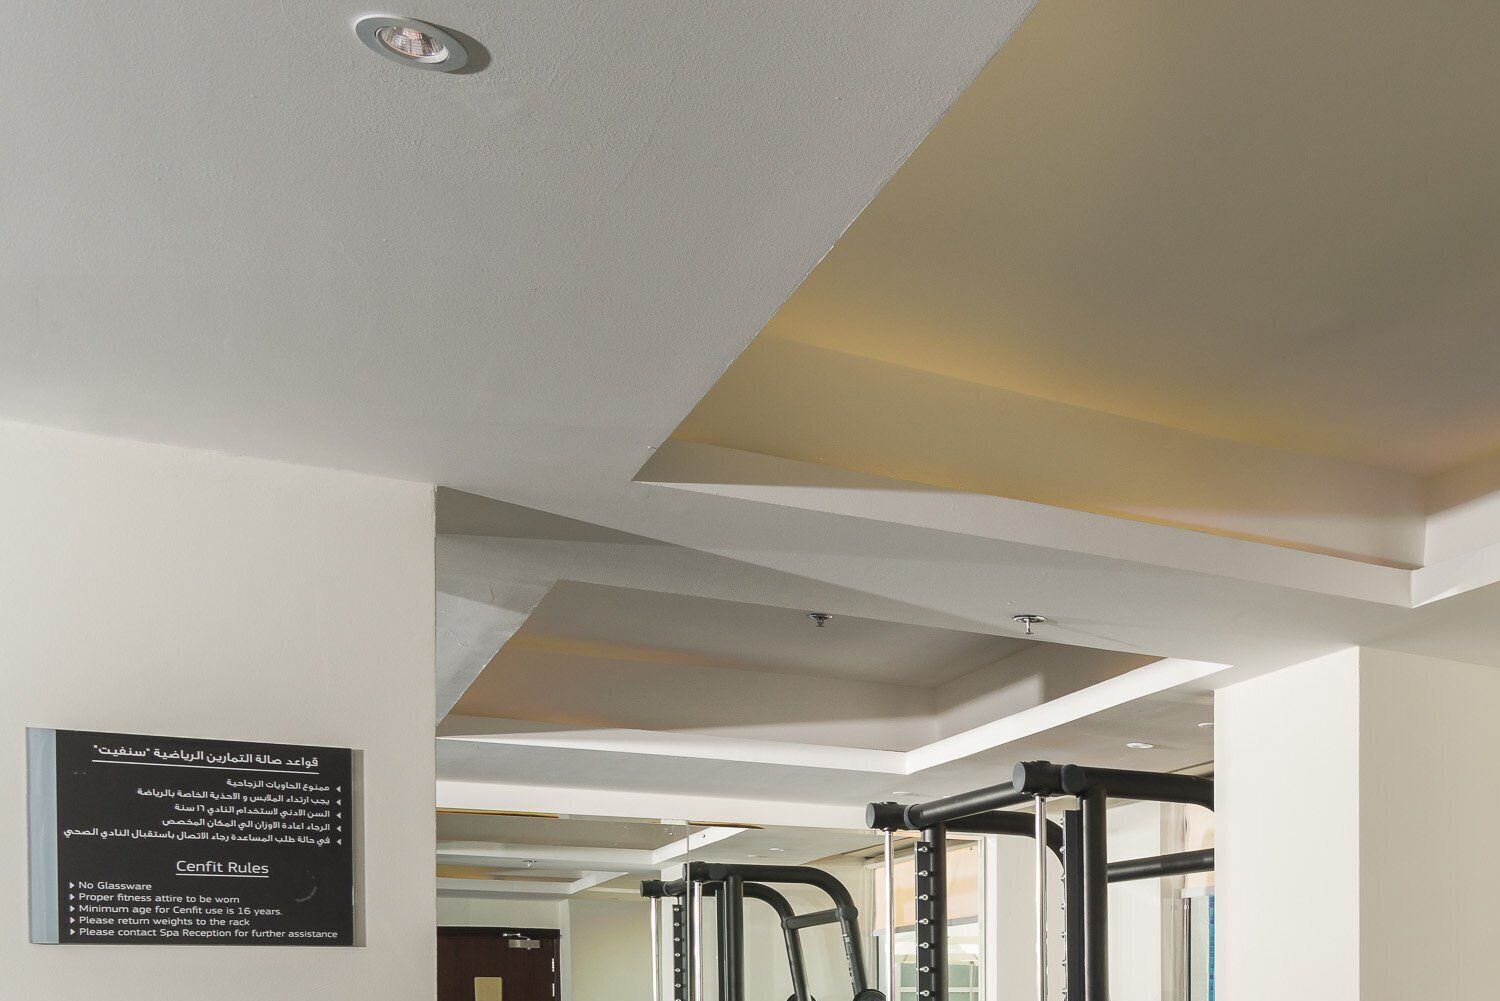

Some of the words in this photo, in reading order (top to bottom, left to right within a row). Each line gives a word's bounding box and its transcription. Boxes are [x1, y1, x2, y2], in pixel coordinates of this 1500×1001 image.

[153, 748, 204, 762] الرياضية
[206, 753, 253, 763] التمارين
[255, 754, 282, 765] صالة
[286, 757, 319, 769] قواعد
[226, 778, 264, 789] الزجاجية
[265, 781, 301, 790] الحاويات
[302, 783, 330, 791] ممنوع
[137, 787, 176, 798] بالرياضة
[176, 790, 208, 799] الخاصة
[210, 791, 241, 800] الاحذية
[249, 795, 284, 803] الملابس
[286, 795, 309, 805] ارتداء
[311, 798, 330, 806] يجب
[174, 803, 195, 812] سنة
[207, 806, 235, 816] النادي
[236, 808, 278, 816] لاستخدام
[307, 810, 330, 819] السن
[162, 818, 205, 826] المخصص
[207, 819, 236, 828] المكان
[254, 820, 280, 830] الاوزان
[282, 821, 304, 830] اعادة
[306, 823, 330, 832] الرجاء
[63, 827, 99, 839] الصحي
[100, 828, 130, 839] النادي
[131, 830, 176, 839] باستقبال
[177, 831, 209, 841] الاتصال
[211, 832, 229, 842] رجاء
[230, 833, 273, 842] المساعدة
[275, 835, 295, 843] طلب
[297, 835, 315, 844] حالة
[316, 837, 331, 847] في
[176, 860, 223, 873] Cenfit
[228, 862, 269, 874] Rules
[79, 881, 94, 890] No
[97, 881, 152, 890] Glassware
[79, 893, 114, 902] Proper
[117, 893, 152, 902] fitness
[155, 894, 183, 903] attire
[186, 895, 197, 903] to
[199, 895, 212, 903] be
[79, 905, 129, 913] Minimum
[132, 907, 152, 915] age
[155, 905, 170, 914] for
[173, 906, 202, 914] Cenfit
[226, 906, 235, 915] is
[238, 907, 251, 915] 16
[79, 916, 115, 925] Please
[118, 917, 150, 925] return
[152, 917, 194, 927] weights
[209, 918, 226, 926] the
[229, 918, 250, 926] rack
[79, 927, 115, 936] Please
[117, 928, 157, 937] contact
[159, 929, 180, 938] Spa
[182, 929, 232, 938] Reception
[234, 929, 249, 937] for
[251, 929, 286, 938] further
[288, 930, 339, 938] assistance
